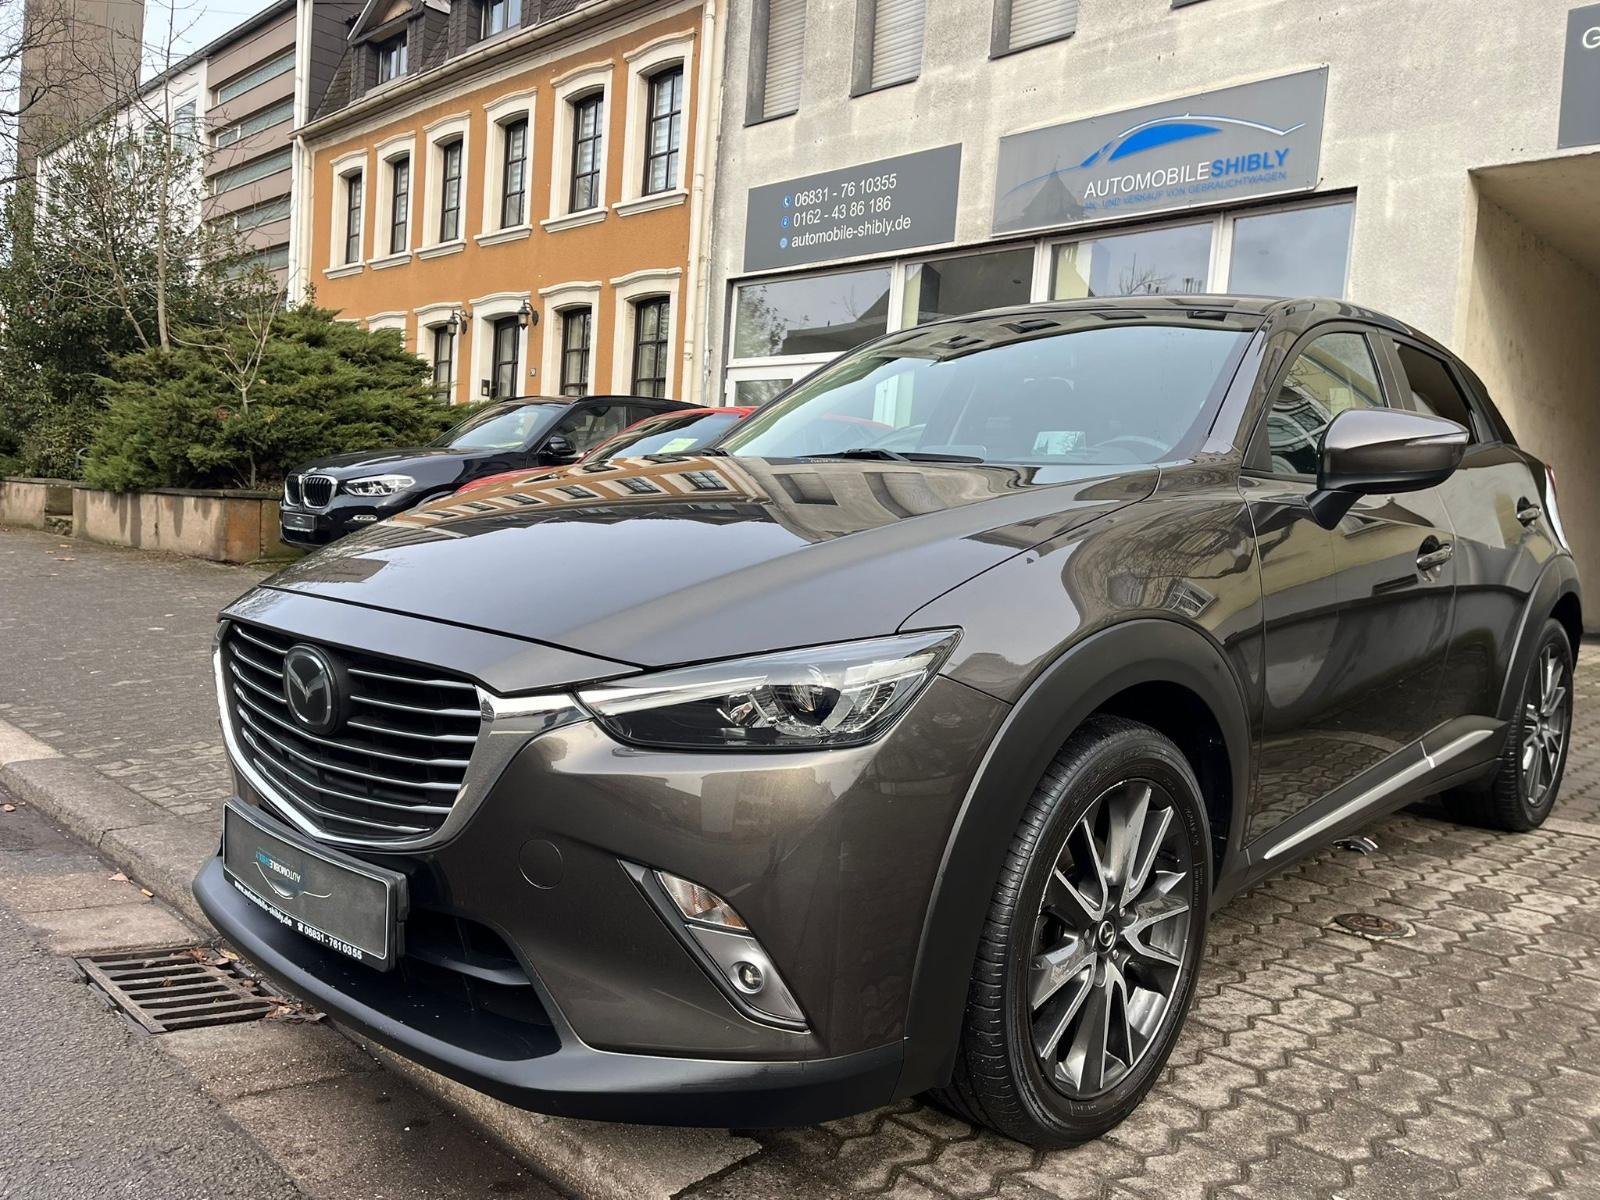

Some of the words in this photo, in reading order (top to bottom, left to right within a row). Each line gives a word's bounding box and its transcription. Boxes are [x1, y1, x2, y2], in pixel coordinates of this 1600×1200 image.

[794, 187, 829, 208] 06831
[840, 181, 856, 199] 76
[859, 173, 897, 194] 10355
[1167, 188, 1186, 197] VON
[1188, 171, 1287, 194] GEBRAUCHTWAGEN
[793, 208, 821, 228] 0162
[832, 203, 847, 221] 43
[849, 199, 865, 217] 86
[869, 195, 892, 214] 186
[791, 214, 912, 248] automobile-shibly.de
[255, 850, 301, 883] AUTOMOBILELY
